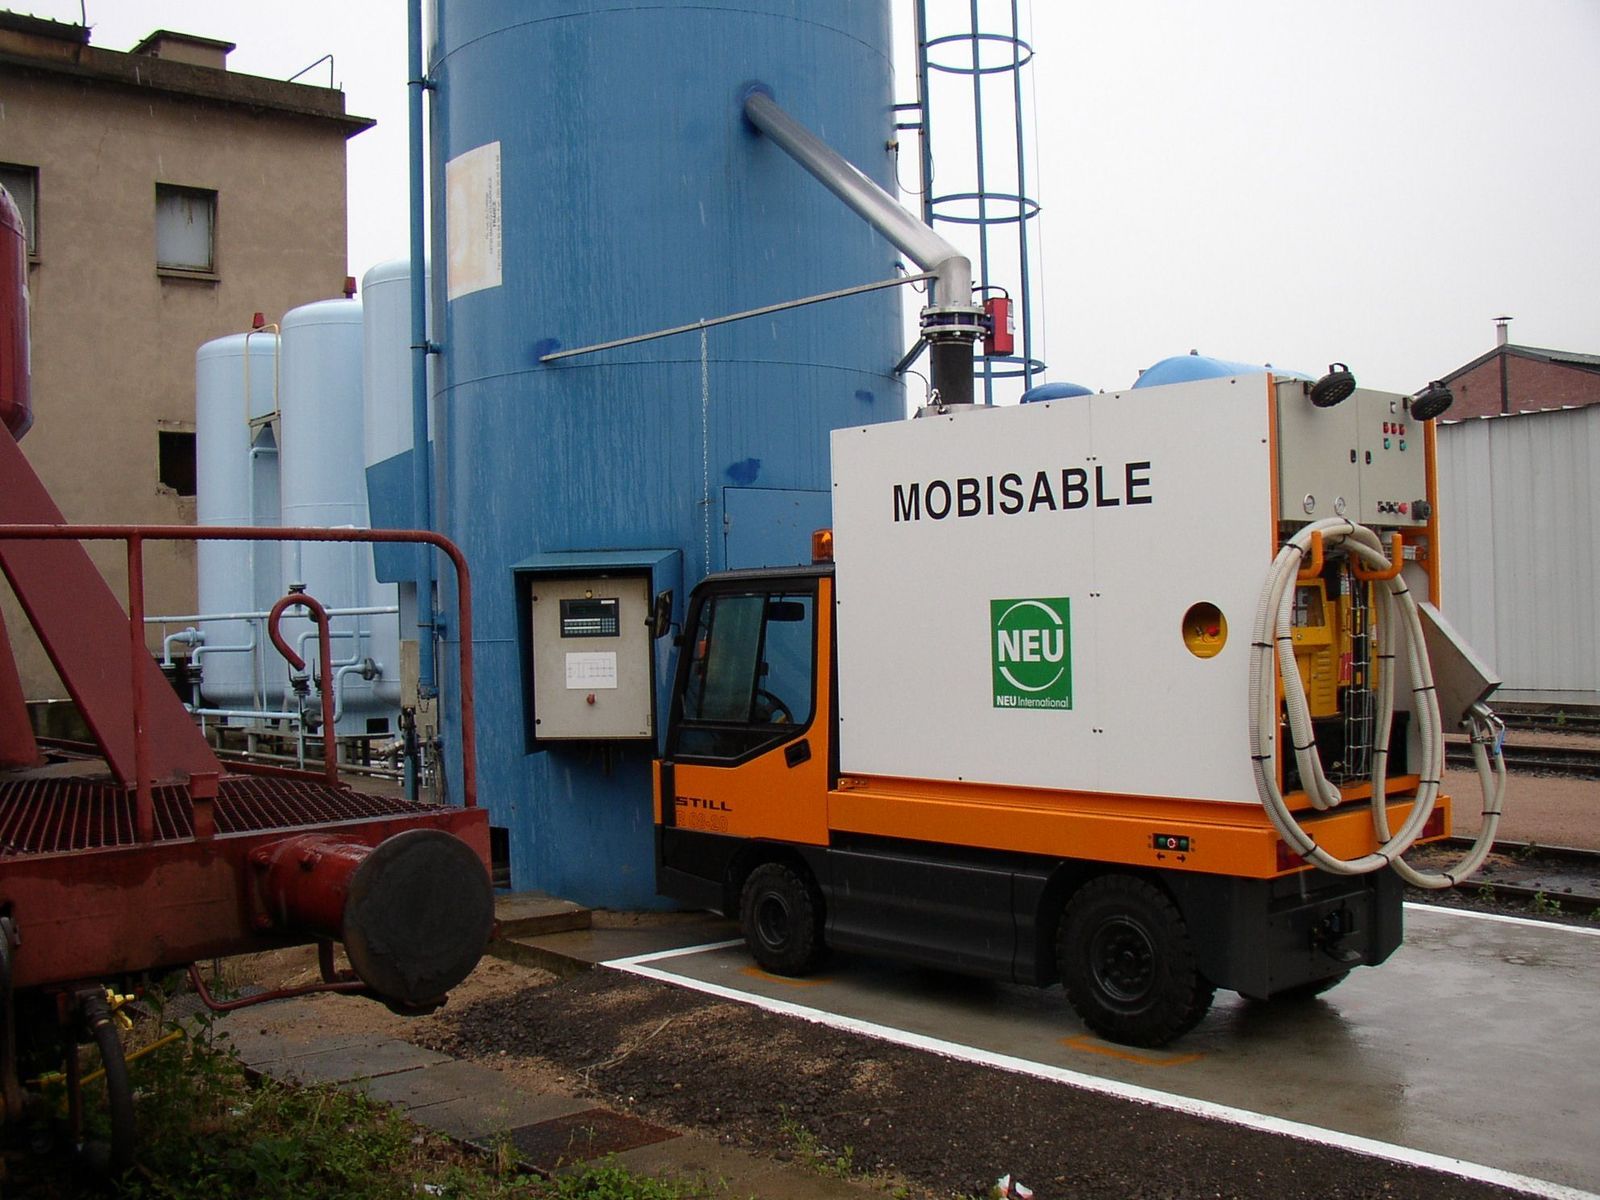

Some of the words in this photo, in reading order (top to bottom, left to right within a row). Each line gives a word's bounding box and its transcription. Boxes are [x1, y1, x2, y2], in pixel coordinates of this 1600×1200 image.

[893, 461, 1152, 522] MOBISABLE
[997, 629, 1065, 663] NEU
[996, 695, 1017, 706] NEU
[1017, 695, 1069, 708] International
[676, 796, 733, 812] STILL
